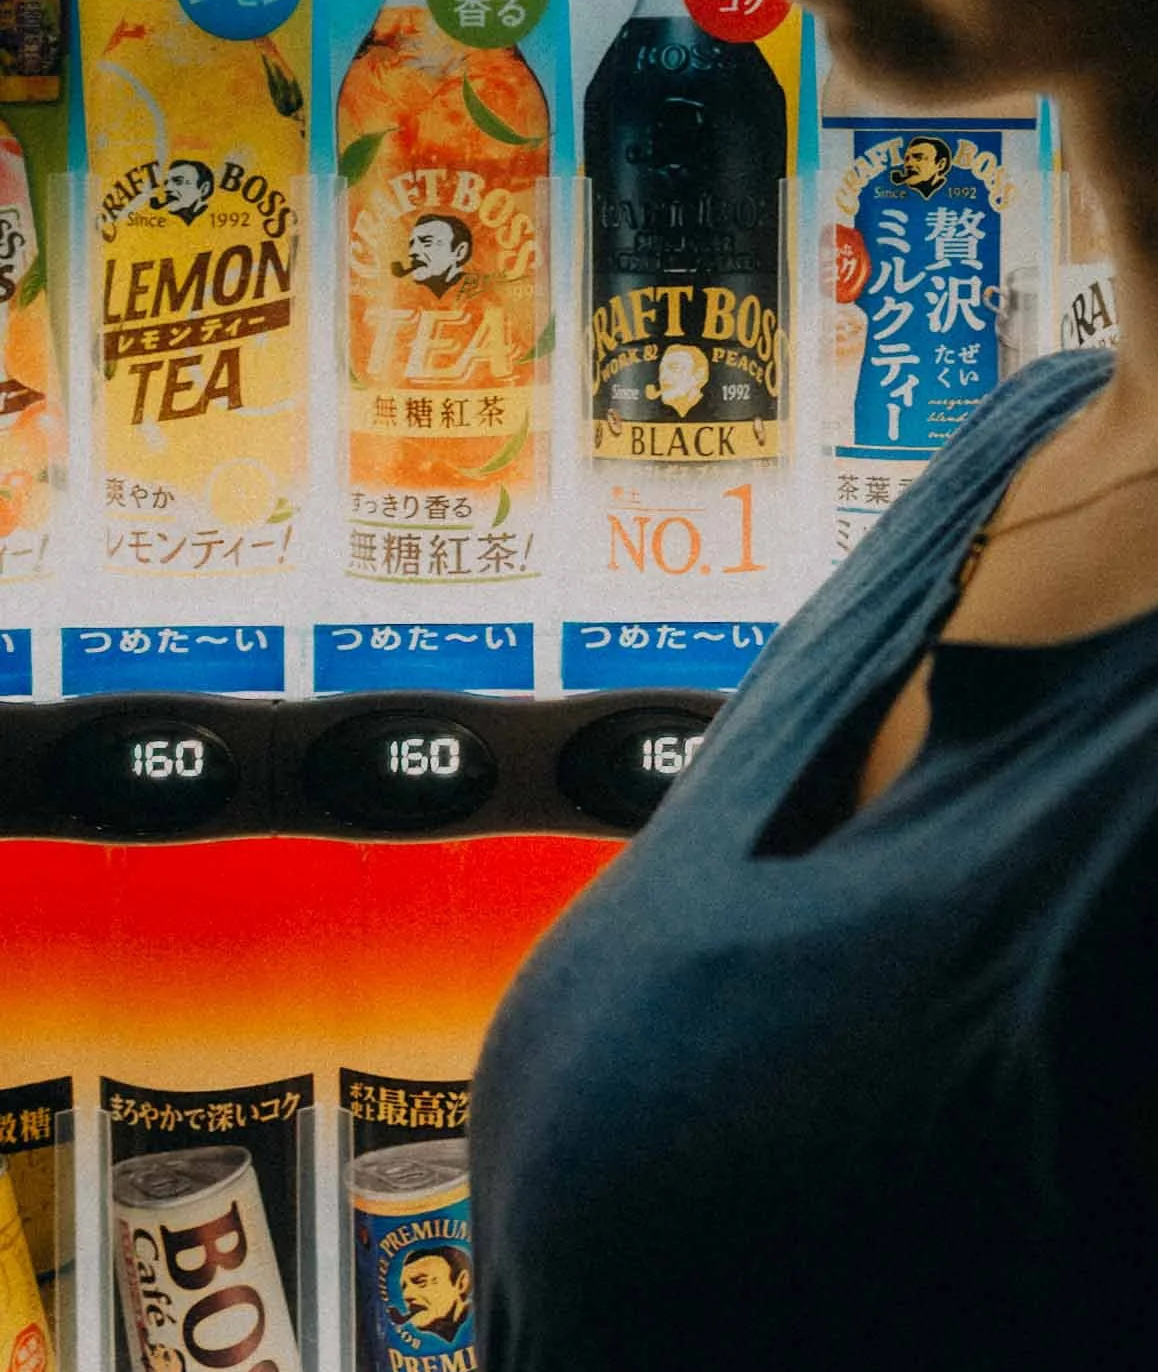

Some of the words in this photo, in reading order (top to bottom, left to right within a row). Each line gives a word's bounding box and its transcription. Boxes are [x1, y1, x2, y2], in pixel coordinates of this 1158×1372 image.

[97, 160, 164, 245] CRAFT
[217, 161, 300, 240] BOSS
[946, 186, 978, 201] 1992
[209, 210, 251, 229] 1992
[101, 240, 294, 326] LEMON
[923, 205, 988, 335] 贅沢
[116, 314, 267, 355] レモンティー
[362, 302, 522, 386] TEA
[701, 286, 791, 398] BOSS
[868, 207, 928, 442] ミルクティー
[128, 345, 245, 426] TEA
[711, 346, 766, 386] PEACE
[372, 394, 507, 430] 無糖紅茶
[721, 383, 751, 401] 1992
[630, 425, 736, 458] BLACK
[104, 476, 178, 511] 爽やか
[351, 490, 474, 521] すっきり香る
[104, 523, 294, 570] レモンティー!
[606, 482, 769, 577] NO.1
[348, 531, 536, 578] 無糖紅茶!
[131, 738, 205, 780] 160
[388, 737, 462, 778] 160
[109, 1090, 303, 1135] まろやかで深いコク
[132, 1227, 178, 1330] Café
